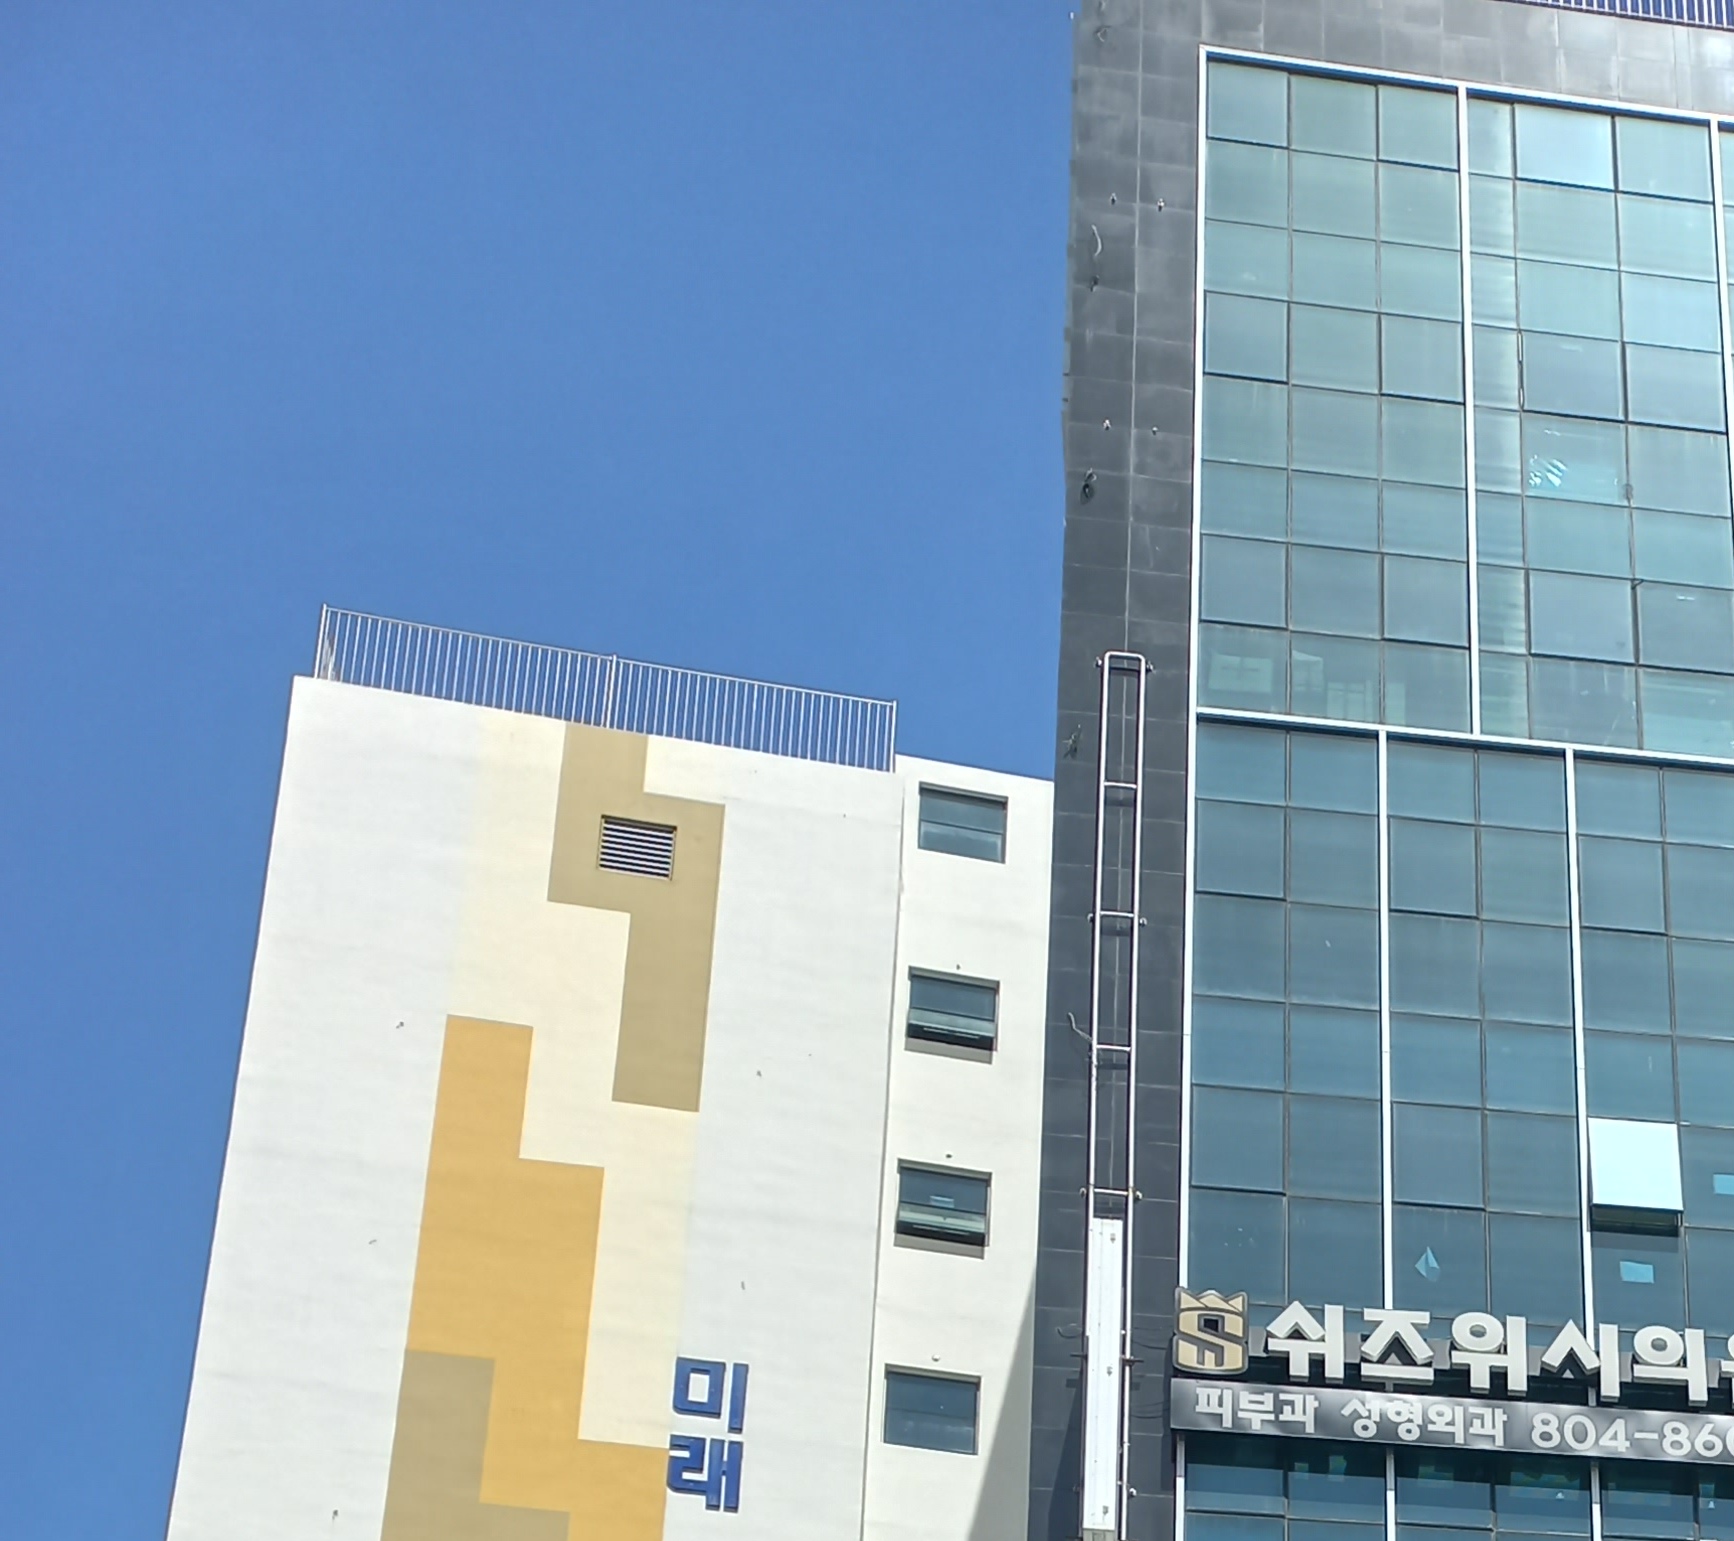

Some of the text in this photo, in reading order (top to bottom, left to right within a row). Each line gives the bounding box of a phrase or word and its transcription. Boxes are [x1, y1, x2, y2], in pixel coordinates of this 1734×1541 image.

[667, 1357, 749, 1513] 미래
[1195, 1386, 1318, 1431] 피부과
[1341, 1397, 1508, 1448] 성형외과
